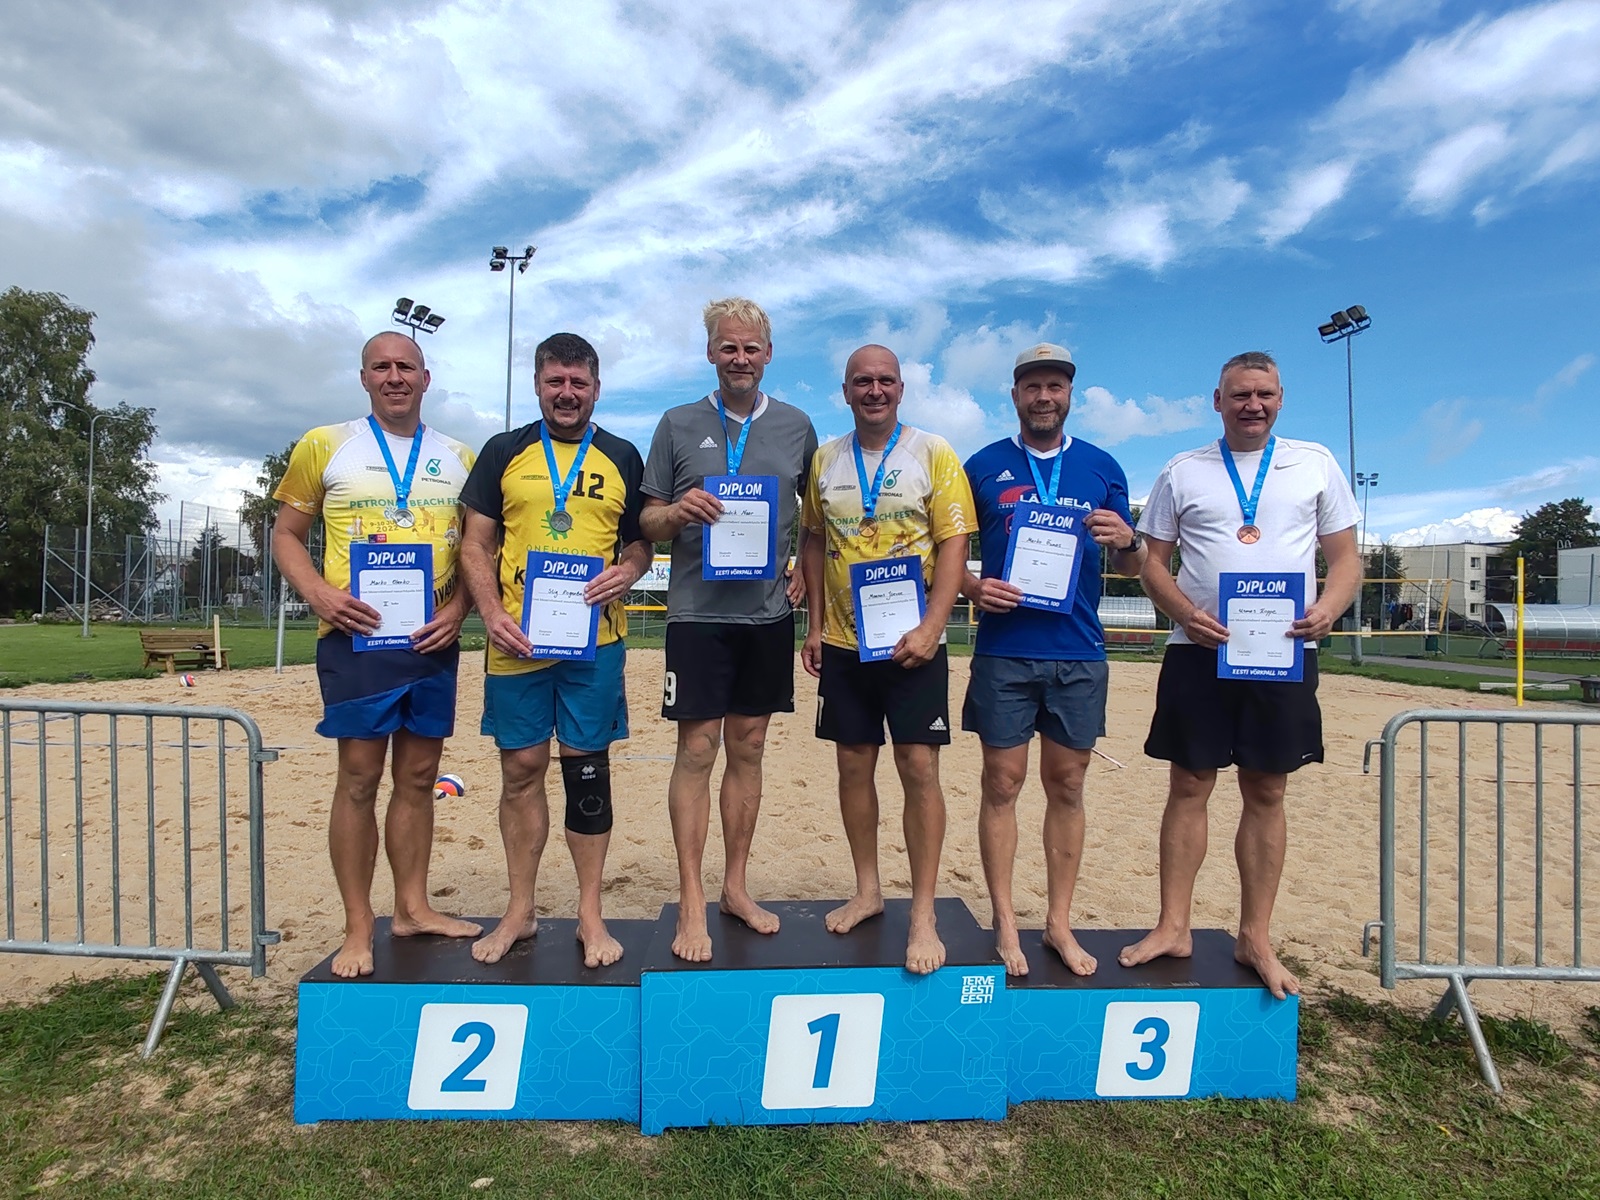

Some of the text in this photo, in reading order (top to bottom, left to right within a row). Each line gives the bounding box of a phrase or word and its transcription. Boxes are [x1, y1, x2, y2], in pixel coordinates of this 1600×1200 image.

[421, 477, 452, 486] PETRONAS
[572, 470, 605, 500] 12
[718, 482, 763, 496] DIPLOM
[349, 498, 461, 509] PETRON BEACH FE
[1019, 493, 1092, 511] LÄNELA
[894, 510, 916, 519] FEST
[1028, 511, 1074, 529] DIPLOM
[526, 544, 588, 556] ONEWOOD
[368, 551, 416, 565] DIPLOM
[543, 560, 589, 577] DIPLOM
[865, 564, 907, 581] DIPLOM
[1236, 580, 1287, 594] DIPLOM
[367, 639, 385, 647] EESTI
[872, 649, 886, 657] EESTI
[1250, 668, 1276, 676] VÕRKPALL
[664, 671, 677, 707] 9
[962, 975, 996, 986] TERVE
[962, 985, 994, 995] EESTI
[807, 1013, 840, 1088] 1
[1125, 1016, 1170, 1081] 3
[440, 1021, 496, 1092] 2
